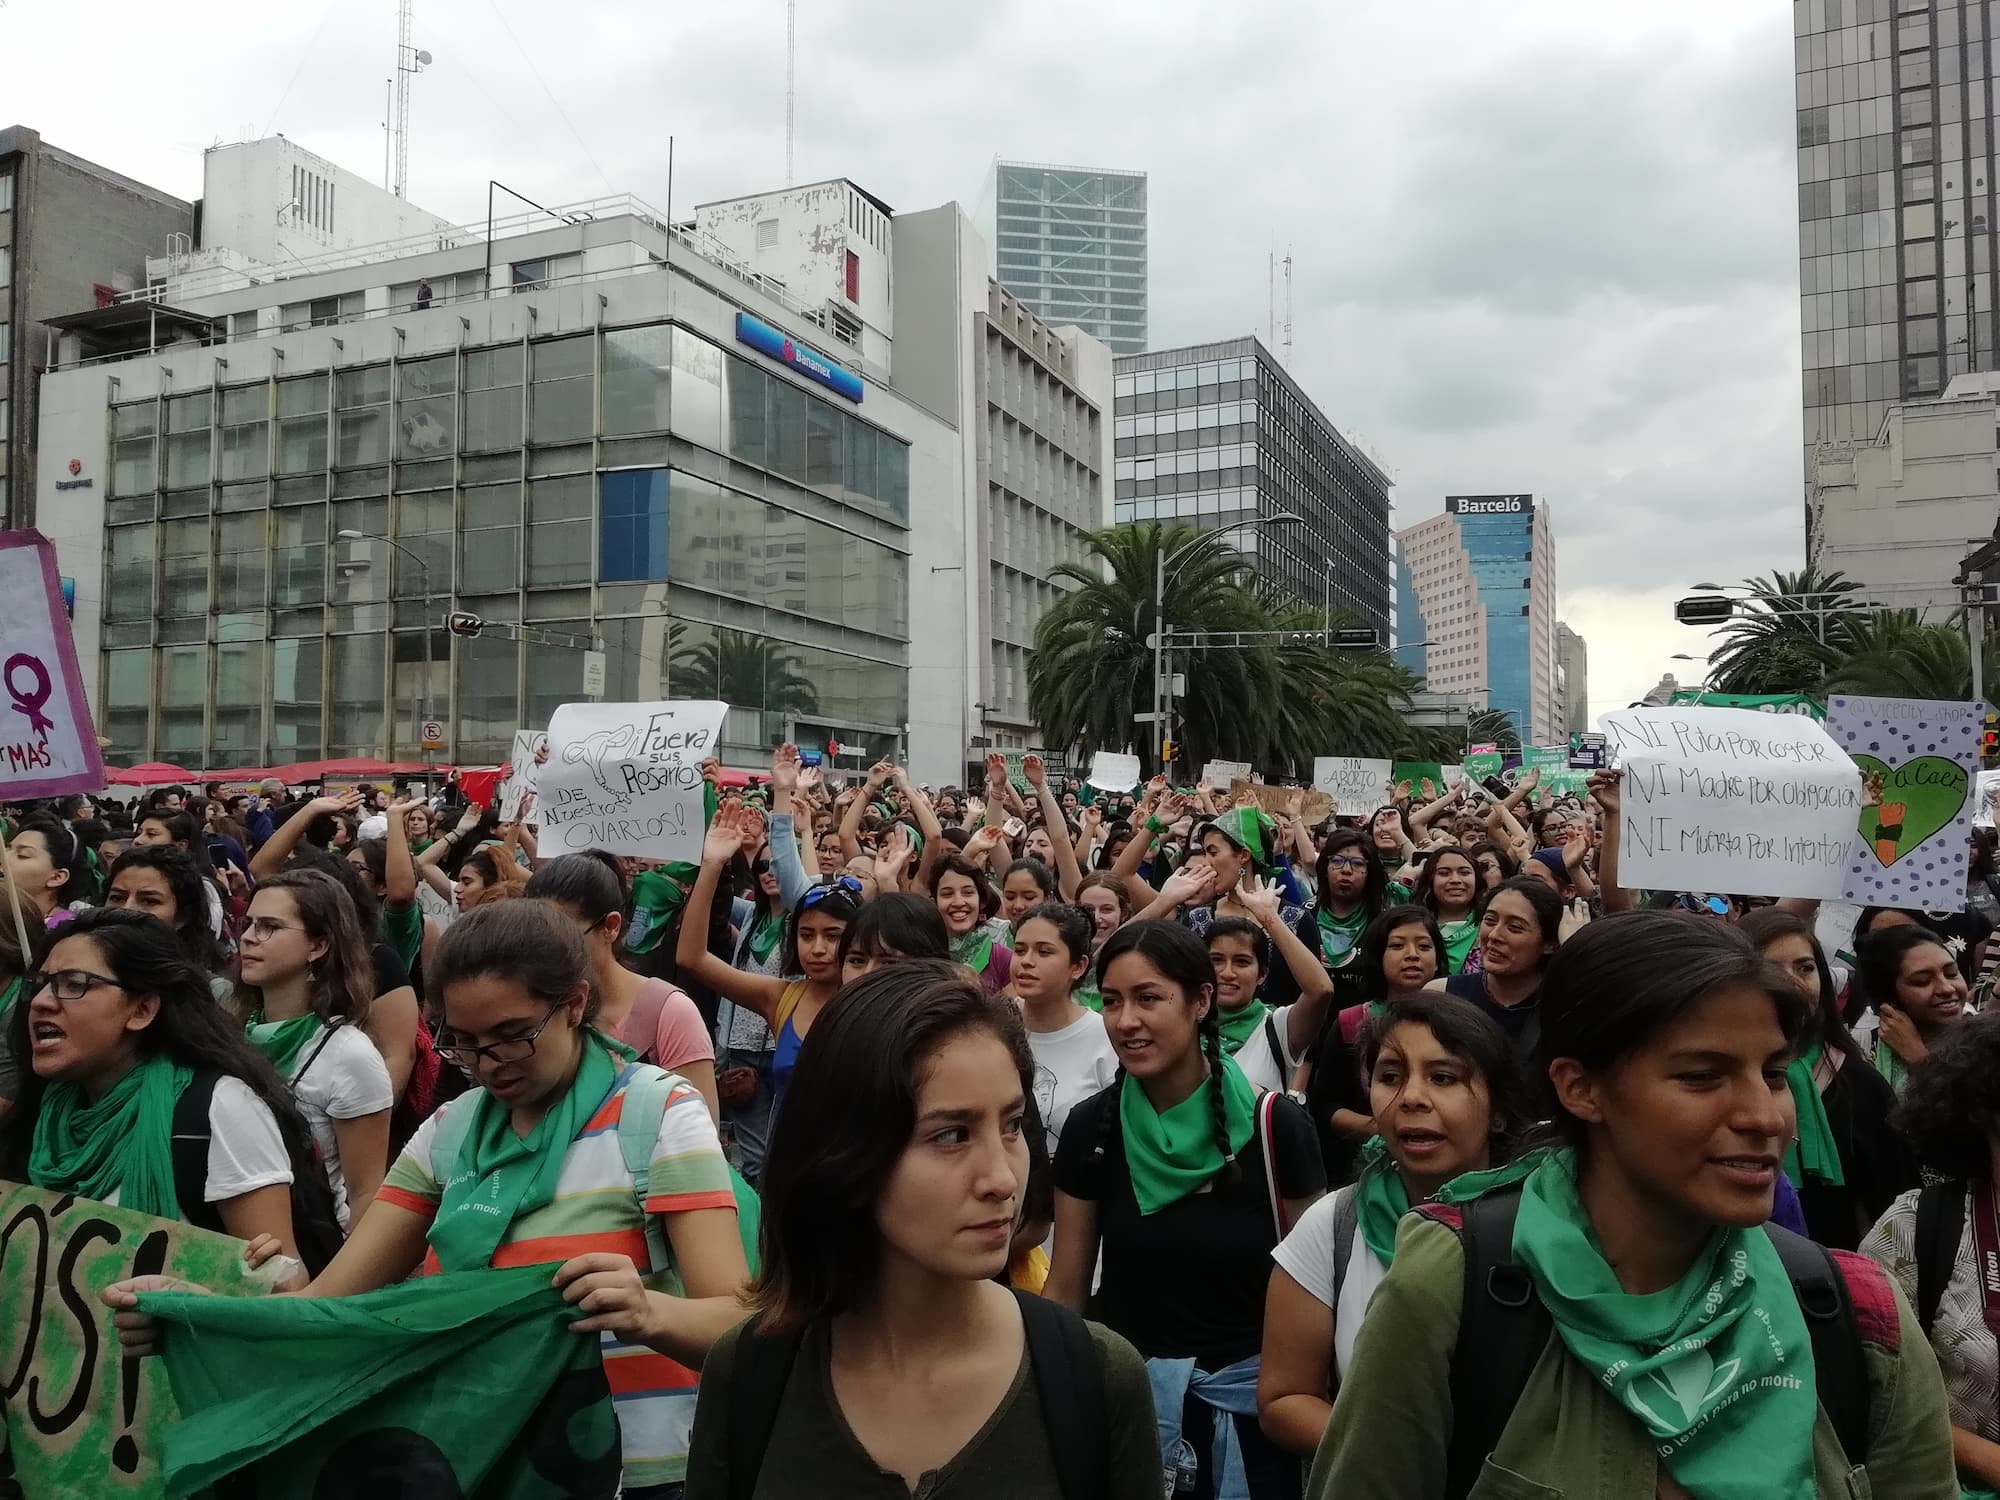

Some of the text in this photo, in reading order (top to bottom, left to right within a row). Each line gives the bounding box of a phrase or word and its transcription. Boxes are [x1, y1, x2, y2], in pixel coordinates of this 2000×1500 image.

[795, 349, 831, 379] Banamex
[1457, 496, 1521, 513] Barceló
[1608, 715, 1668, 750] NI
[620, 760, 704, 796] Rosarios
[1323, 770, 1377, 787] ABORTO
[1343, 759, 1362, 769] SIN
[555, 787, 588, 806] DE
[1627, 763, 1672, 803] NI
[545, 800, 631, 826] Nuestros
[564, 803, 687, 848] OVARIOS!
[1627, 816, 1672, 858] NI
[472, 1202, 502, 1217] morir
[1730, 1250, 1748, 1288] todo
[1754, 1306, 1785, 1364] abortar
[1602, 1358, 1629, 1387] para
[1741, 1377, 1757, 1394] no
[1760, 1374, 1804, 1391] morir
